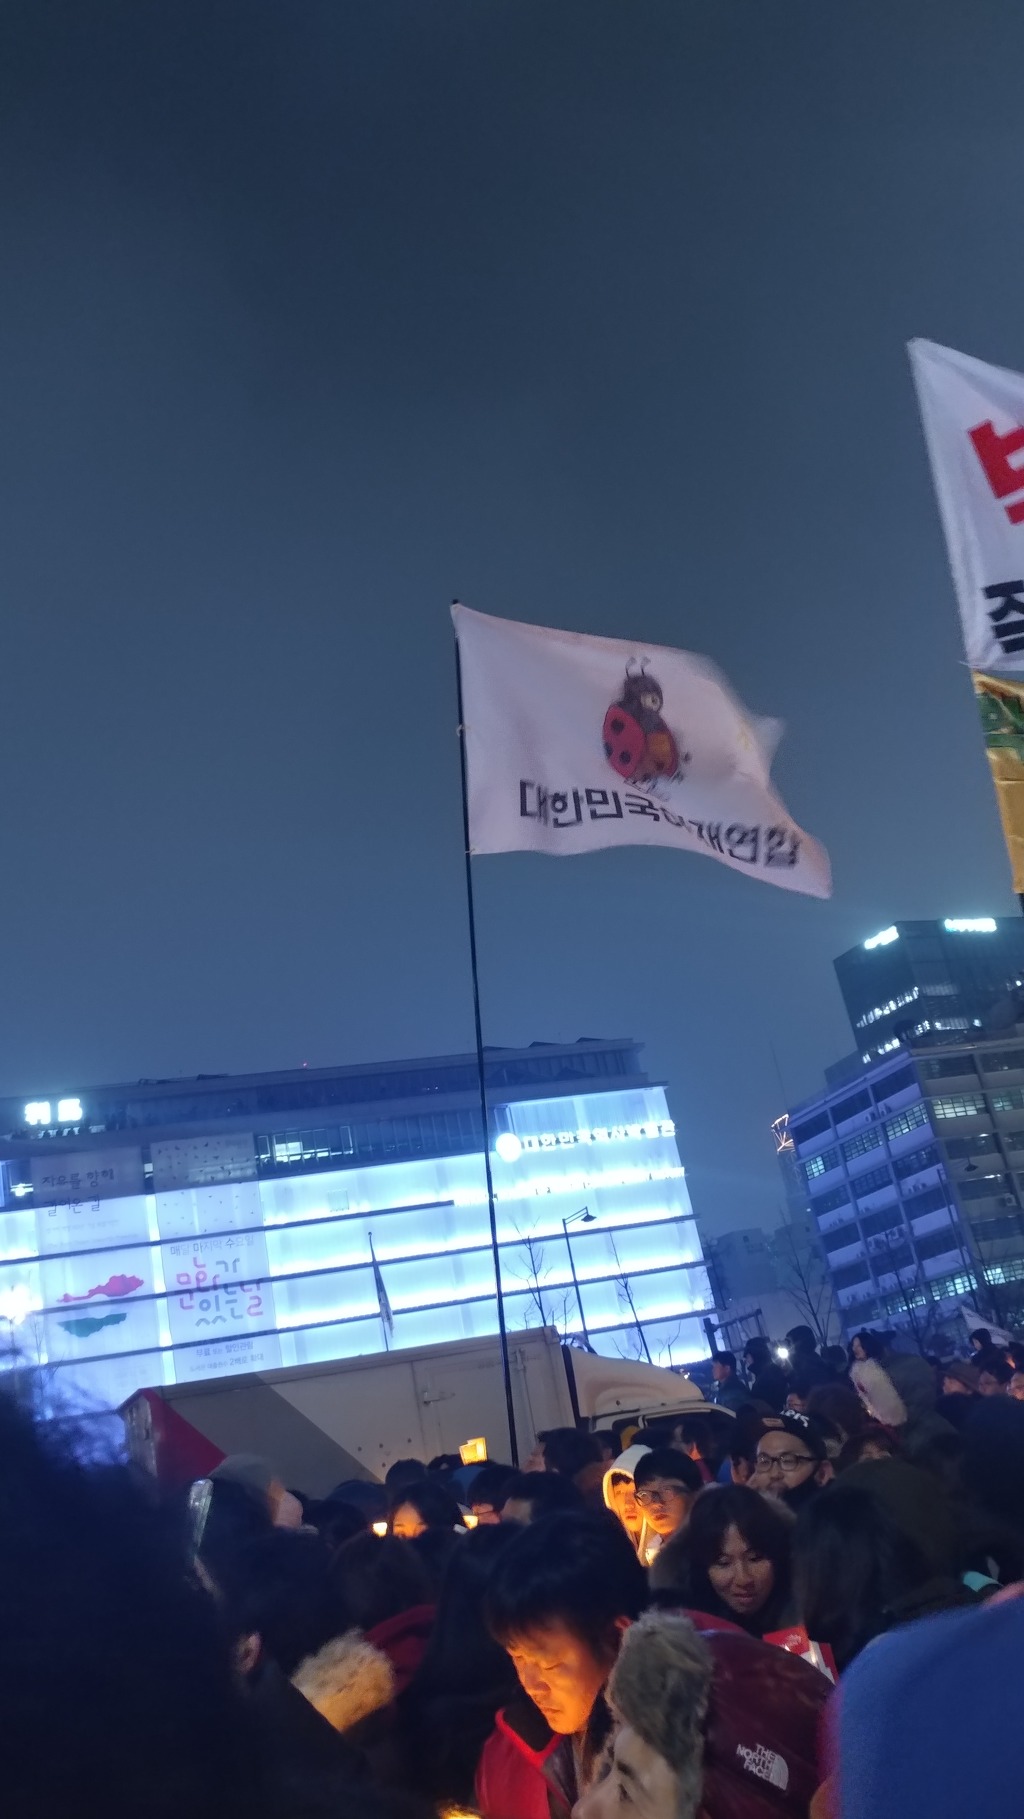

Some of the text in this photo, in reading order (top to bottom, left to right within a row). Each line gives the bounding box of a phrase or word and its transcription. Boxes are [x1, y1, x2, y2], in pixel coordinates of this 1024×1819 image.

[736, 1743, 774, 1771] NORTH
[755, 1743, 777, 1761] THE
[743, 1759, 771, 1780] FACE
